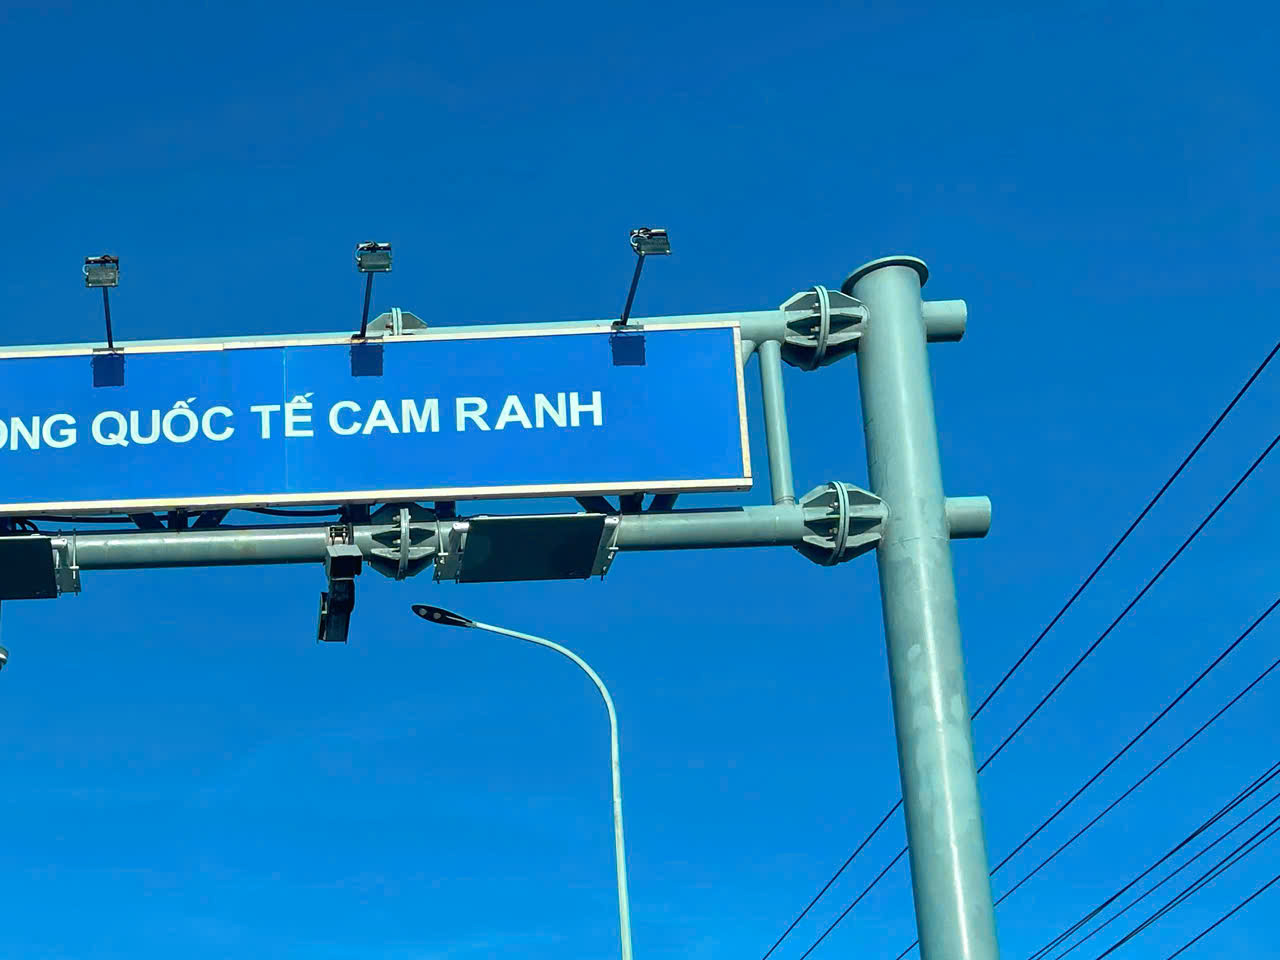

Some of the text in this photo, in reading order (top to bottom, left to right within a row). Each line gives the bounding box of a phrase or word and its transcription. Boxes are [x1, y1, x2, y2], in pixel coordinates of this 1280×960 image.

[91, 397, 235, 447] QUỐC
[250, 391, 314, 439] TẾ
[328, 398, 440, 436] CAM
[455, 390, 604, 432] RANH
